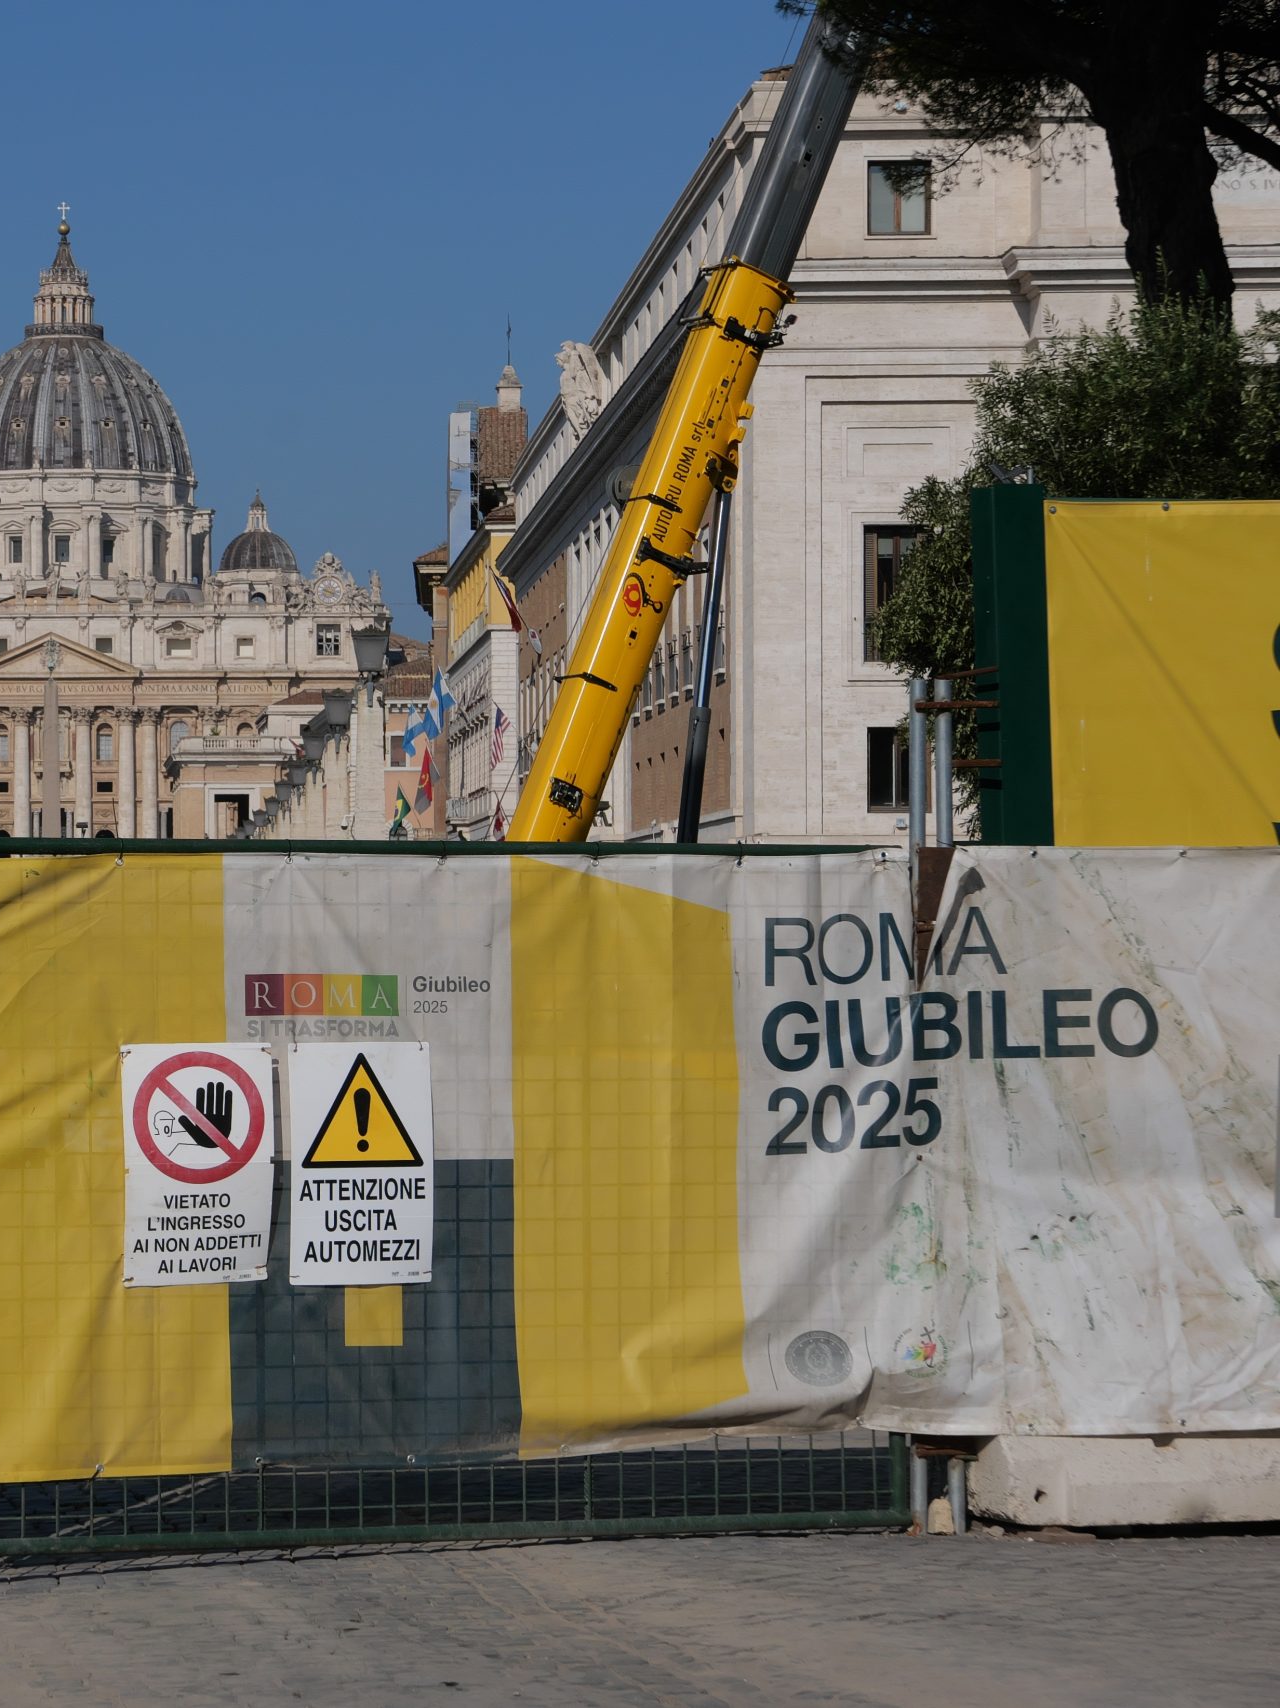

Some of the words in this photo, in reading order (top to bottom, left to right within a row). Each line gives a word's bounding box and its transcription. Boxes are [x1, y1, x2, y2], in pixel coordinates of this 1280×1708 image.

[651, 484, 683, 543] AUTORU
[672, 446, 698, 483] ROMA
[764, 907, 1007, 987] ROMA
[254, 980, 391, 1009] ROMA
[413, 976, 490, 993] Giubileo
[413, 1001, 447, 1014] 2025
[247, 1020, 264, 1038] SI
[272, 1019, 399, 1037] TRASFORMA
[762, 988, 1159, 1072] GIUBILEO
[765, 1078, 942, 1156] 2025
[164, 1193, 231, 1209] VIETATO
[299, 1178, 425, 1202] ATTENZIONE
[147, 1214, 245, 1231] L'INGRESSO
[324, 1209, 397, 1232] USCITA
[133, 1239, 149, 1253] AI
[154, 1237, 190, 1252] NON
[194, 1234, 261, 1251] ADDETTI
[304, 1239, 420, 1263] AUTOMEZZI
[158, 1259, 173, 1274] AI
[178, 1256, 236, 1273] LAVORI
